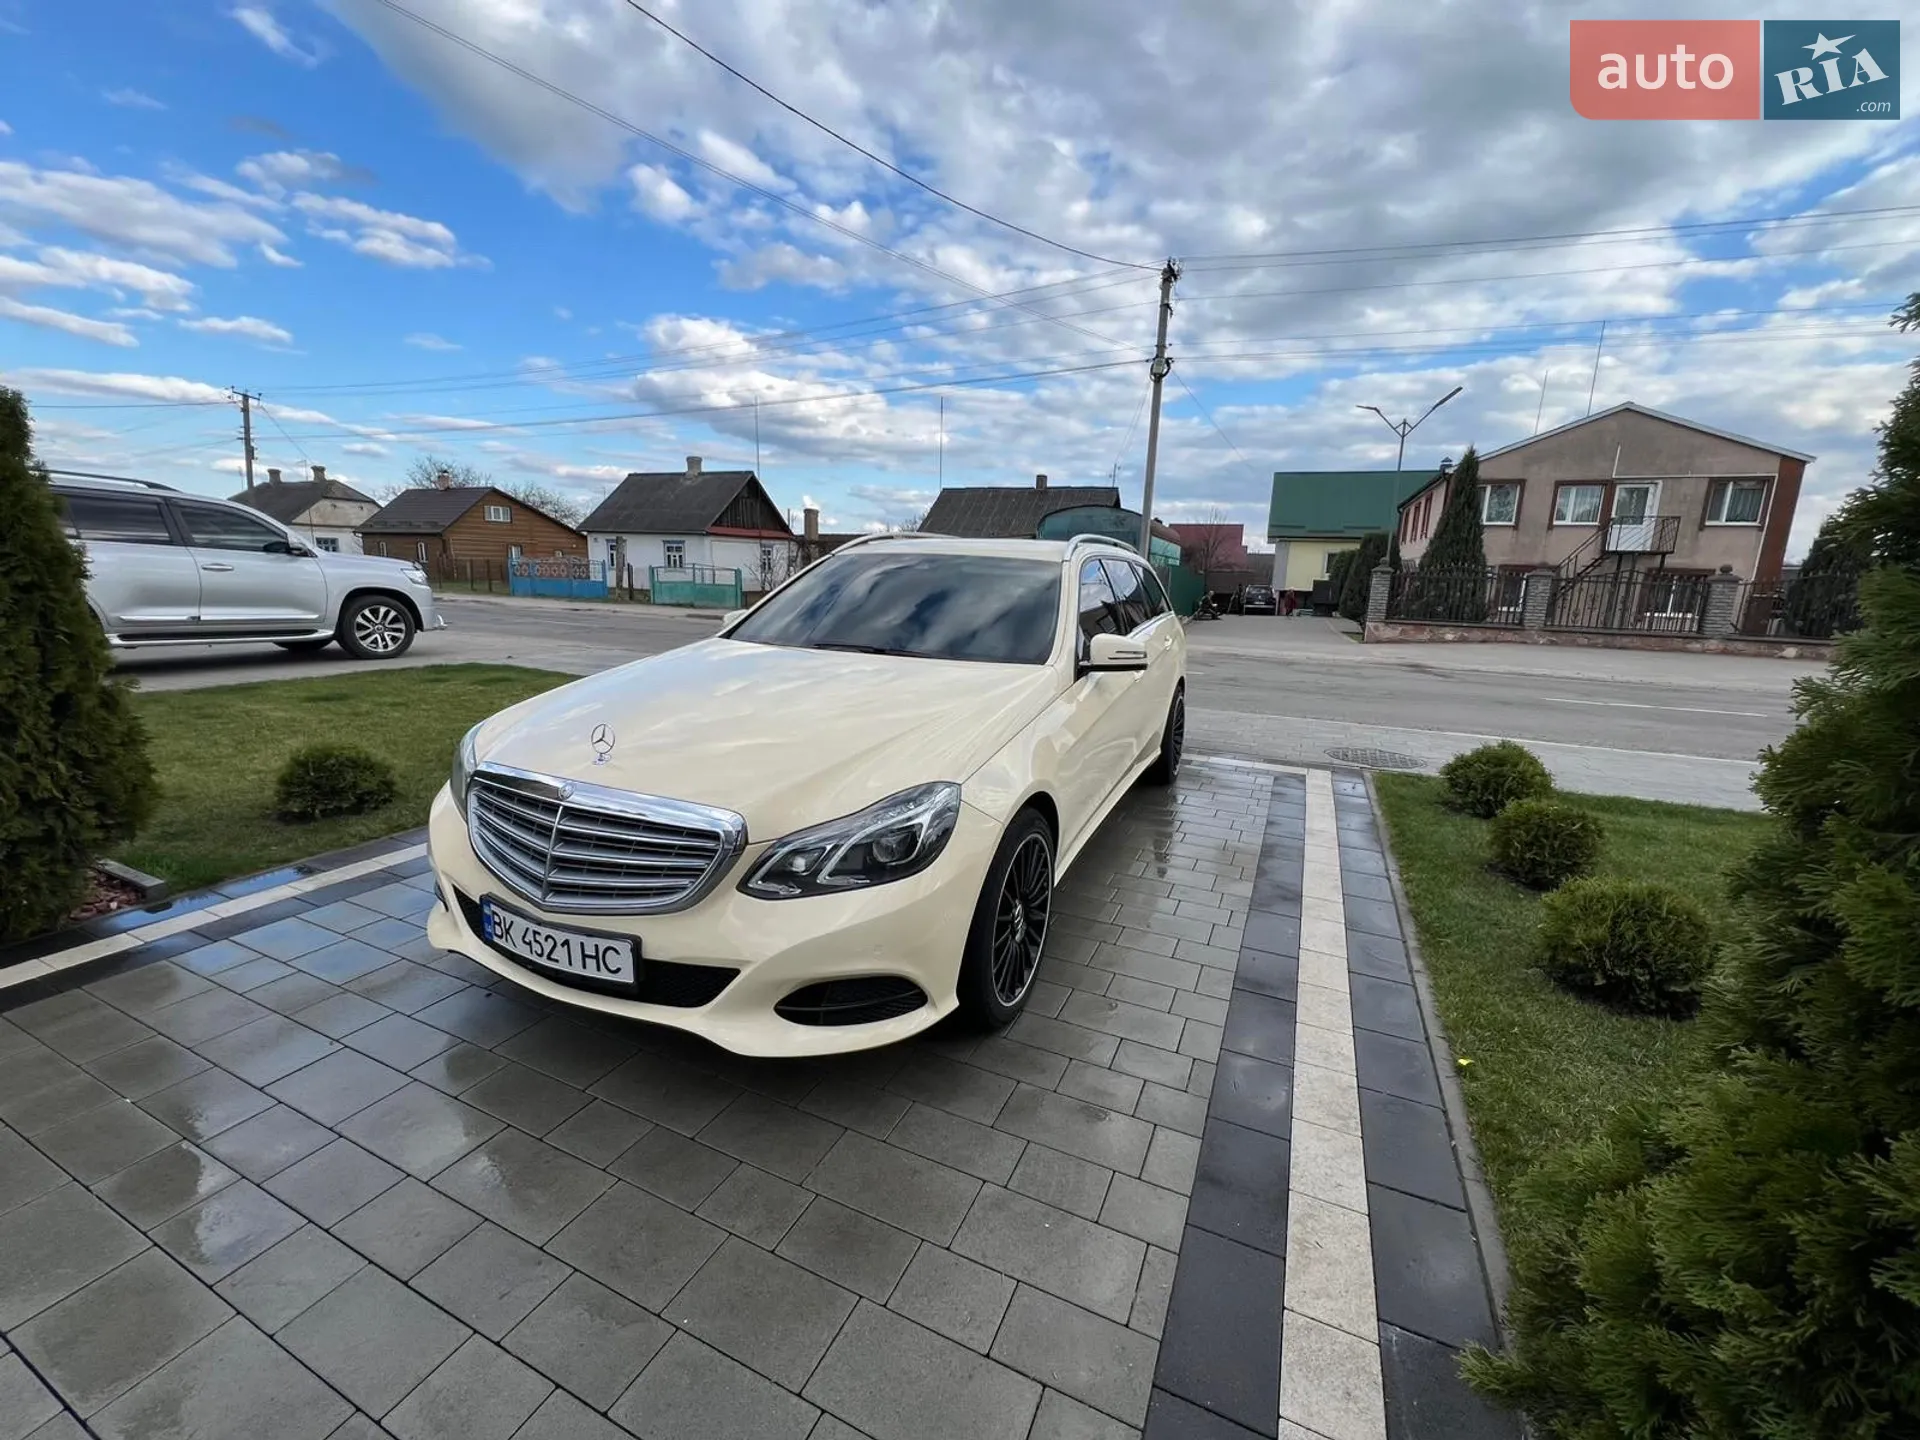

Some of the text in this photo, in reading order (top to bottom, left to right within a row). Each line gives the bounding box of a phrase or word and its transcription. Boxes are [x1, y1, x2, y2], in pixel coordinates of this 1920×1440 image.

[492, 909, 622, 975] BK 4521 HC
